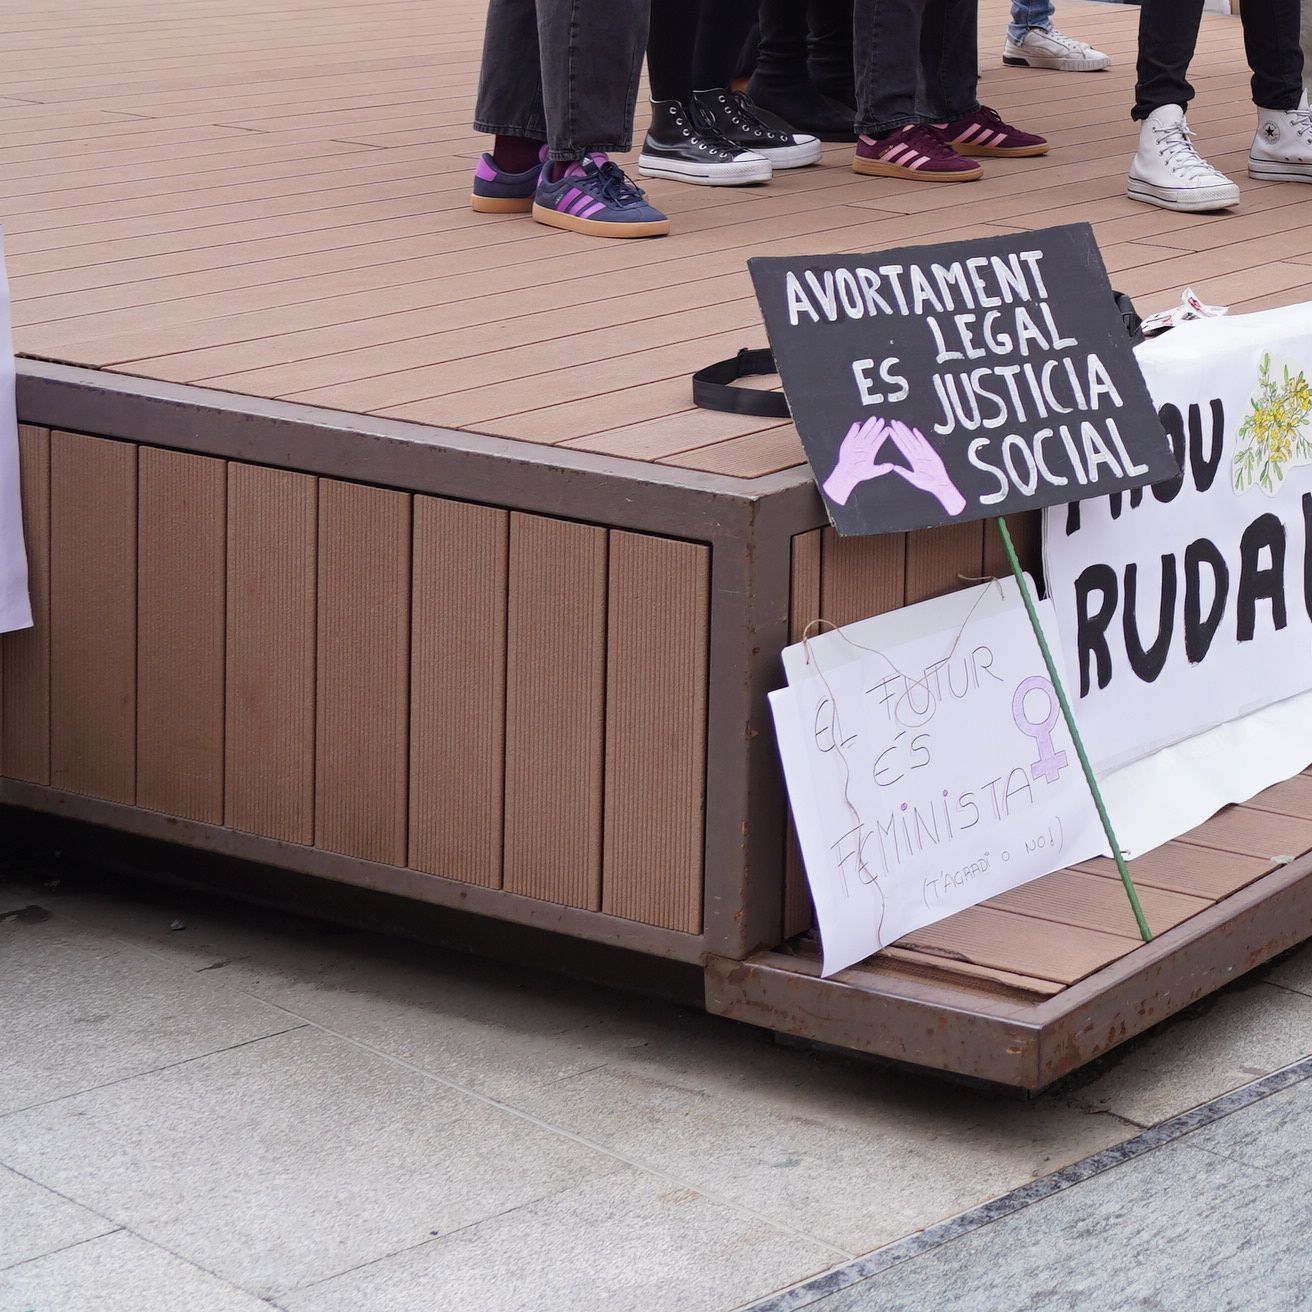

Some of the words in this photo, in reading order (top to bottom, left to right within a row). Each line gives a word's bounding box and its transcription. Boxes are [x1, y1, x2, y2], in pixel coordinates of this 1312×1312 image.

[787, 249, 1046, 326] AVORTAMENT
[927, 306, 1078, 364] LEGAL
[852, 356, 909, 407] ES
[932, 353, 1123, 435] JUSTICIA
[967, 417, 1149, 505] SOCIAL
[815, 695, 858, 752] EL
[866, 645, 1004, 720] FUTUR
